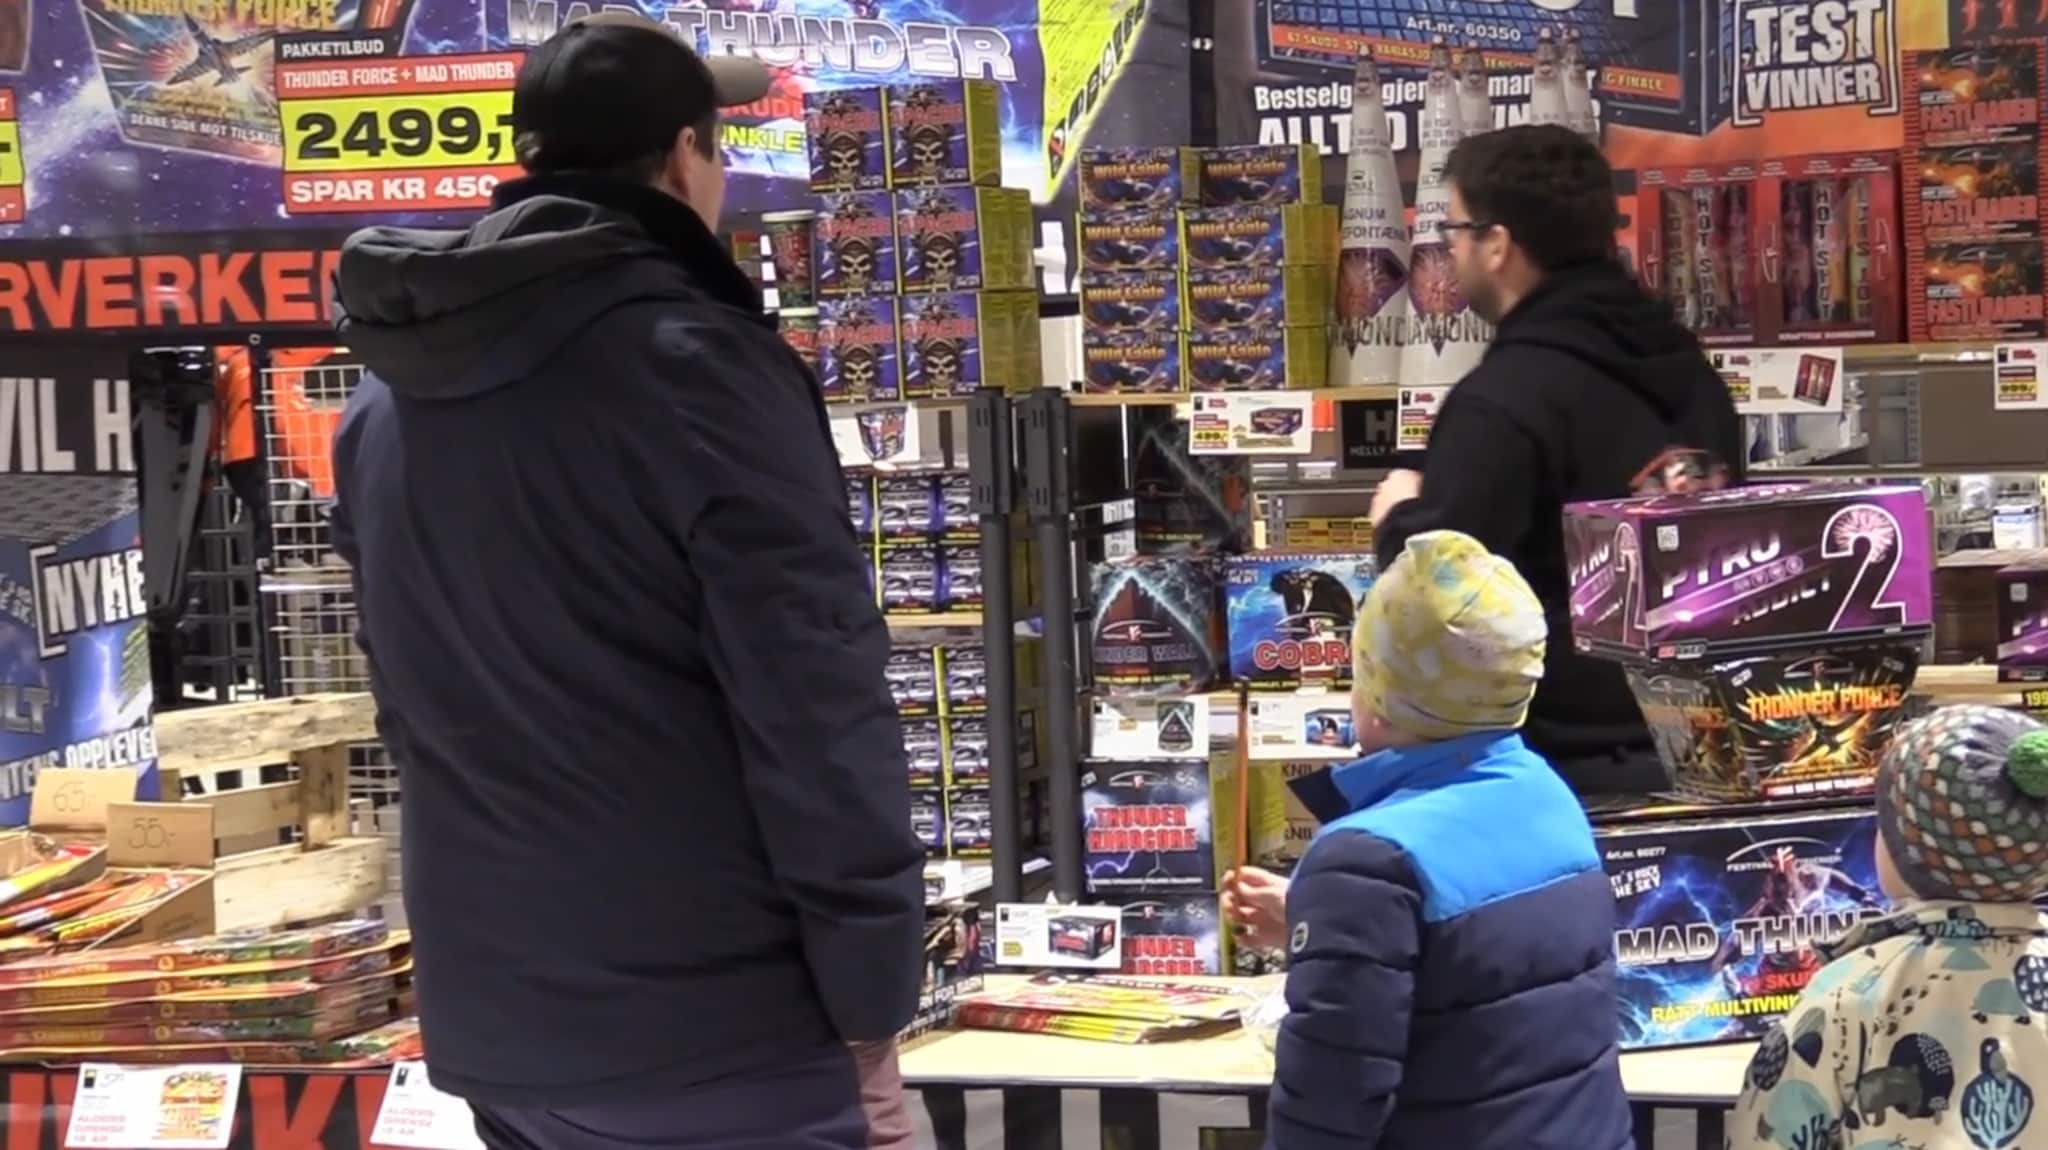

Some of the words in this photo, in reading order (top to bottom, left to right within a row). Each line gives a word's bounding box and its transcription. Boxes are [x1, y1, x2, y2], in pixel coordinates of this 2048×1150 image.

[663, 8, 1016, 81] THUNDER
[1406, 15, 1459, 35] Art.nr.
[1465, 22, 1521, 42] 60350
[1744, 0, 1882, 67] TEST
[282, 39, 384, 59] PAKKETILBUD
[283, 70, 348, 89] THUNDER
[352, 67, 398, 86] FORCE
[415, 64, 451, 83] MAD
[453, 61, 515, 82] THUNDER
[1744, 63, 1883, 112] VINNER
[1254, 84, 1352, 112] Bestselg
[291, 178, 376, 203] SPAR
[382, 176, 426, 200] KR
[0, 249, 338, 332] RVERKE
[1821, 503, 1907, 633] 2
[1253, 639, 1352, 671] COBR
[1746, 686, 1837, 722] THUNDER
[1094, 804, 1189, 828] THUNDER
[1615, 922, 1720, 966] MAD
[1732, 907, 1890, 955] THUN
